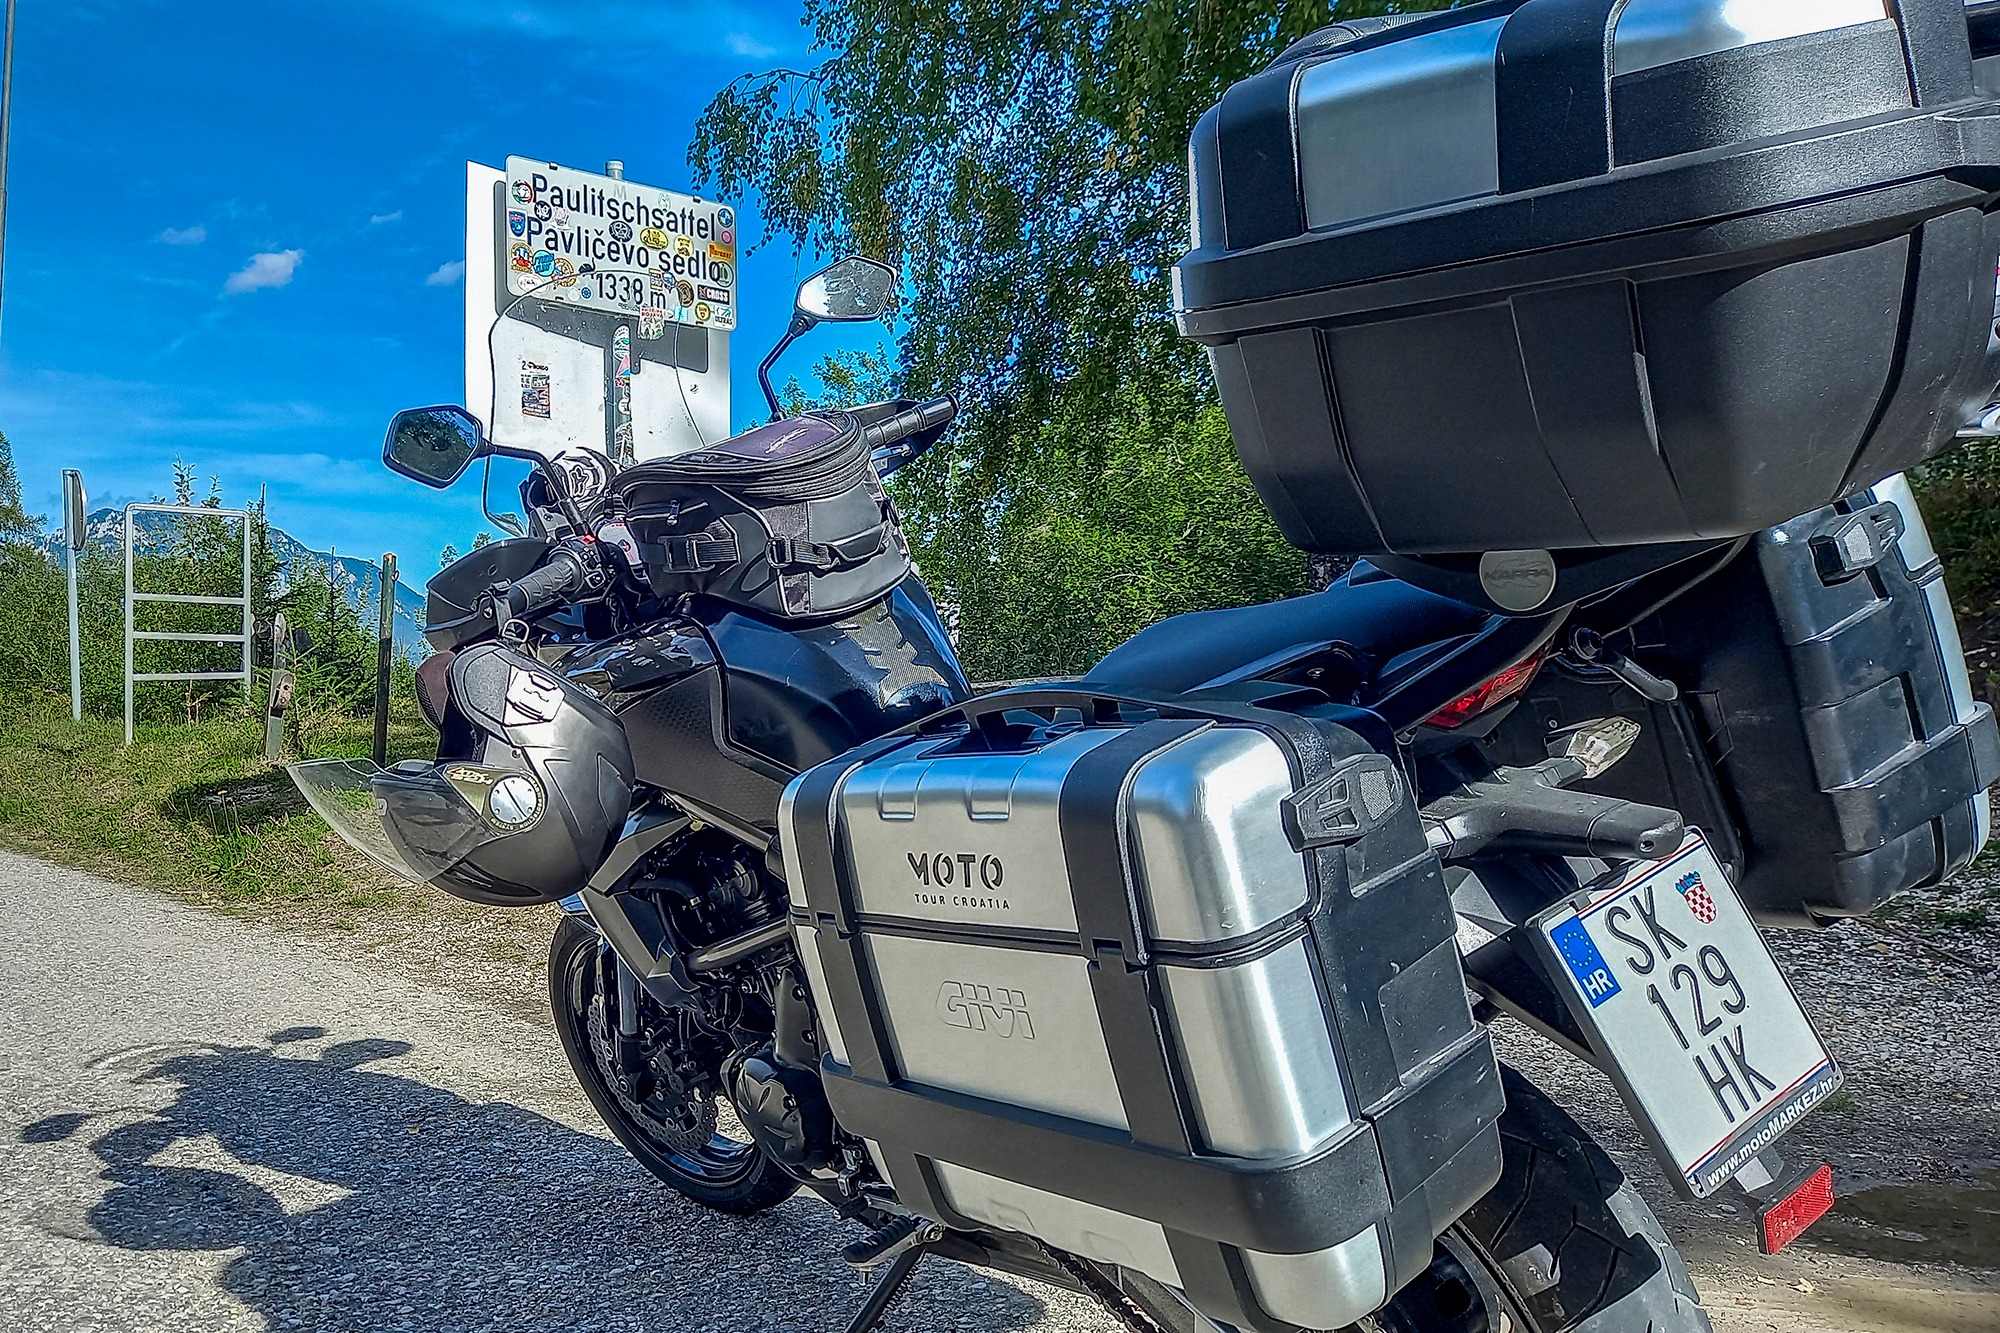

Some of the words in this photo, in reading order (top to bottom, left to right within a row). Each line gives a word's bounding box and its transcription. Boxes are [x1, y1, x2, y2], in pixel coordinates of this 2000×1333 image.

[531, 173, 715, 241] Paulitschsattel
[528, 216, 649, 268] Pavličevo
[659, 250, 720, 282] sedlo
[597, 273, 643, 305] 1338
[650, 291, 666, 310] m
[907, 852, 1004, 890] MOTO
[915, 893, 946, 905] TOUR
[953, 896, 1010, 910] CROATIA
[1606, 885, 1688, 976] SK
[936, 980, 1035, 1039] GIVI
[1581, 967, 1614, 1001] HR
[1647, 944, 1747, 1050] 129
[1694, 1025, 1776, 1124] HK
[1706, 1077, 1835, 1187] www.motoMARKEZ.hr
